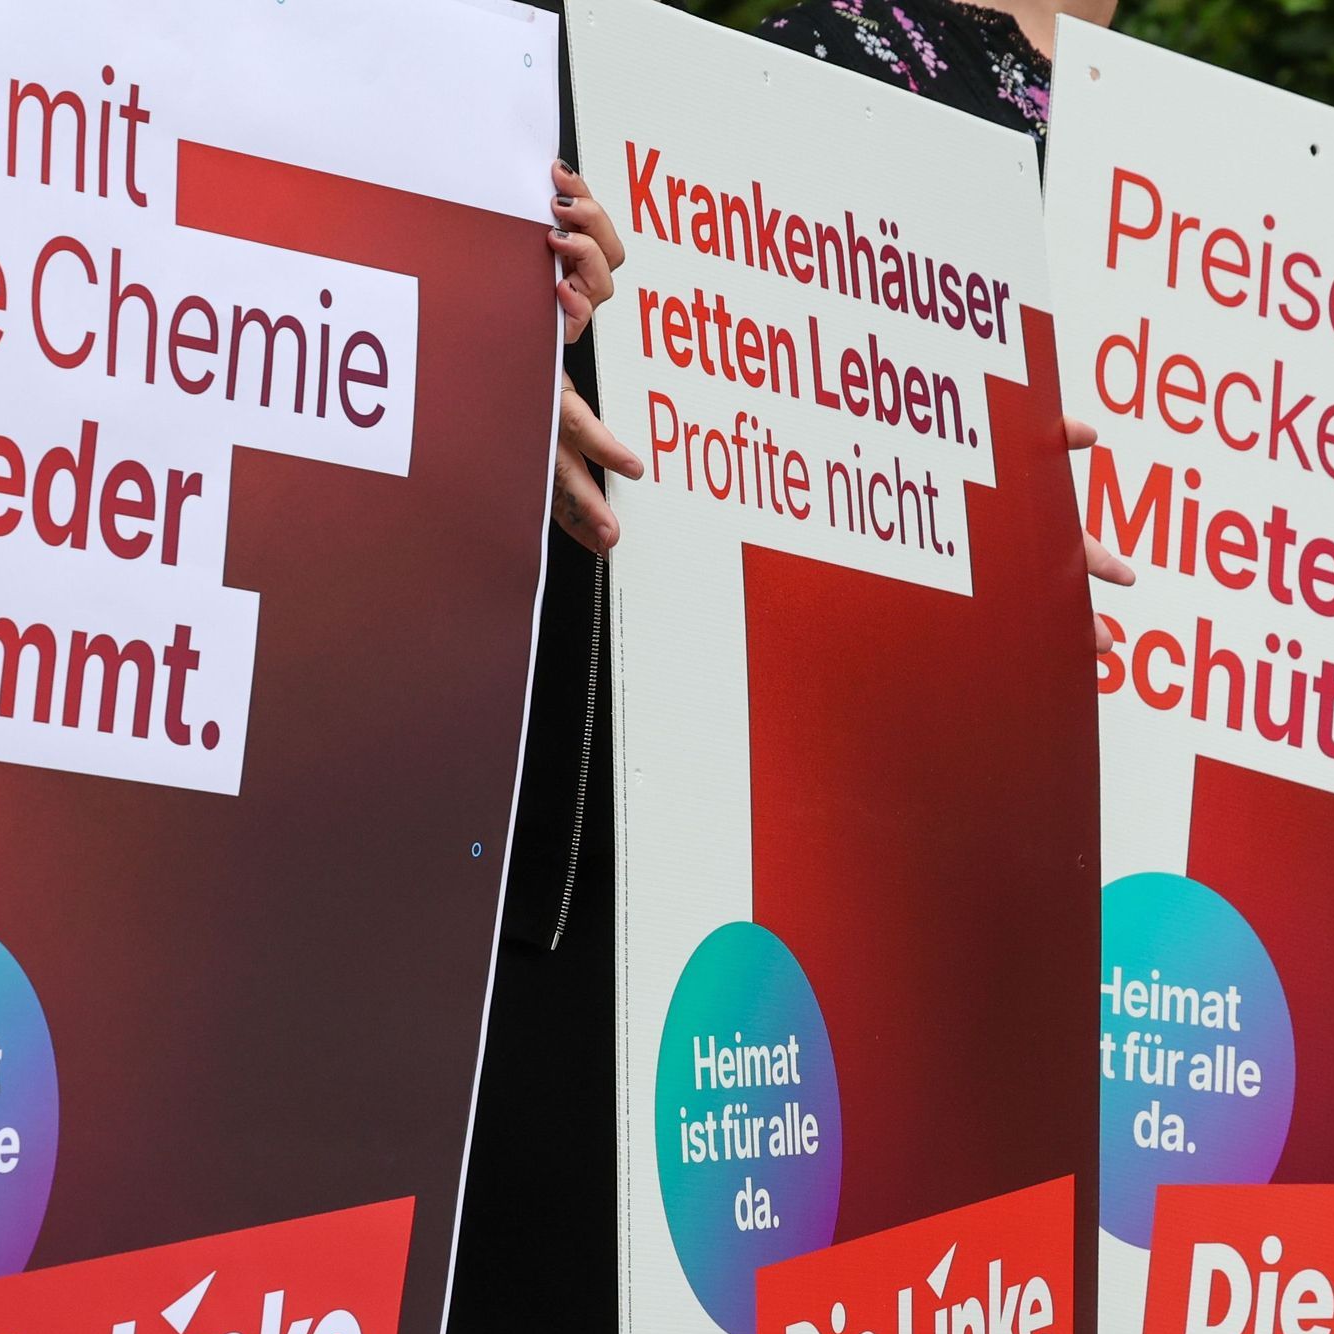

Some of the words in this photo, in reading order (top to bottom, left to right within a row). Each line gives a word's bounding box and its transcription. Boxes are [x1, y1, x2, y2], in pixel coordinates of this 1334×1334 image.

[626, 141, 1009, 344] Krankenhäuser
[32, 236, 387, 427] Chemie
[639, 288, 799, 398] retten
[809, 315, 979, 450] Leben.
[649, 391, 810, 520] Profite
[827, 445, 954, 556] nicht.
[695, 1033, 800, 1088] Heimat
[1123, 1032, 1184, 1086] für
[1189, 1045, 1263, 1098] alle
[681, 1108, 718, 1162] ist
[721, 1104, 764, 1159] für
[769, 1103, 818, 1157] alle
[1134, 1101, 1196, 1154] da.
[735, 1177, 779, 1231] da.
